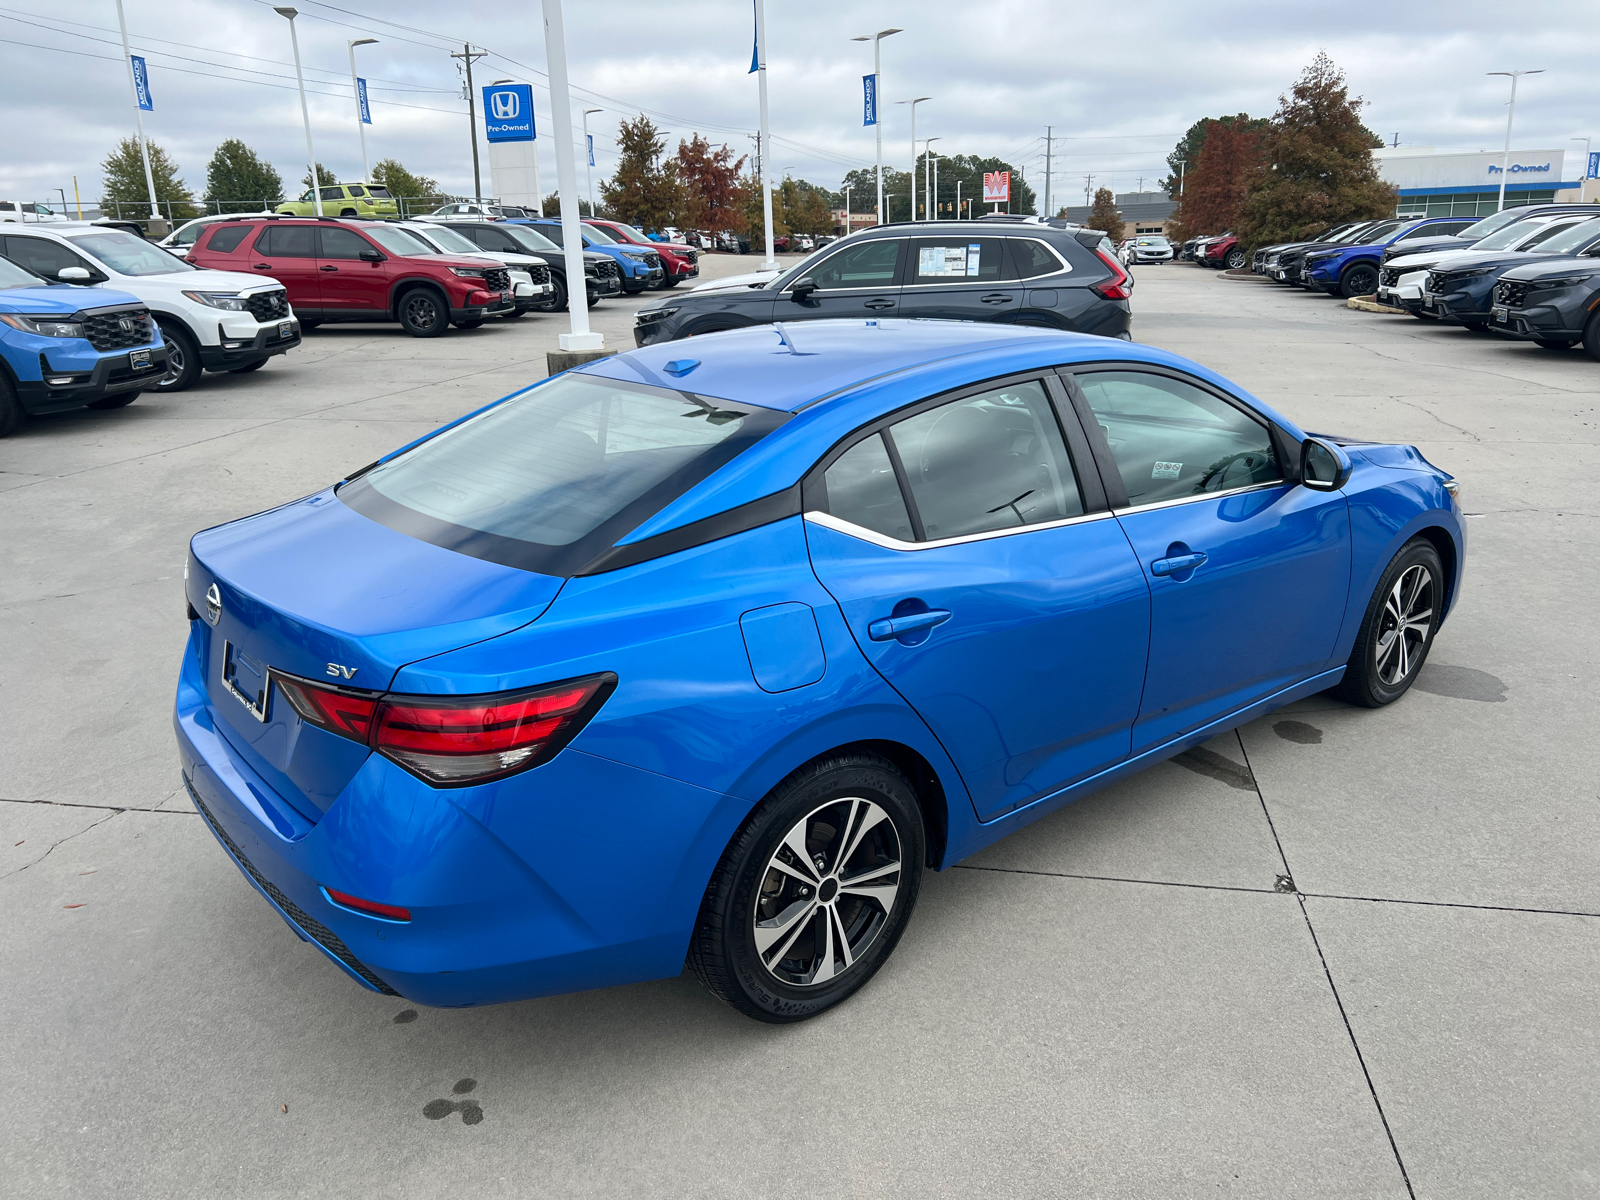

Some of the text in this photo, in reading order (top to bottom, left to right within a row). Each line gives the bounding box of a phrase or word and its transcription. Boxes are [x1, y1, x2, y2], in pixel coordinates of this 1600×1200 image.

[133, 59, 146, 105] MIDLANDS
[487, 123, 529, 133] Pre-Owned
[326, 662, 359, 680] SV
